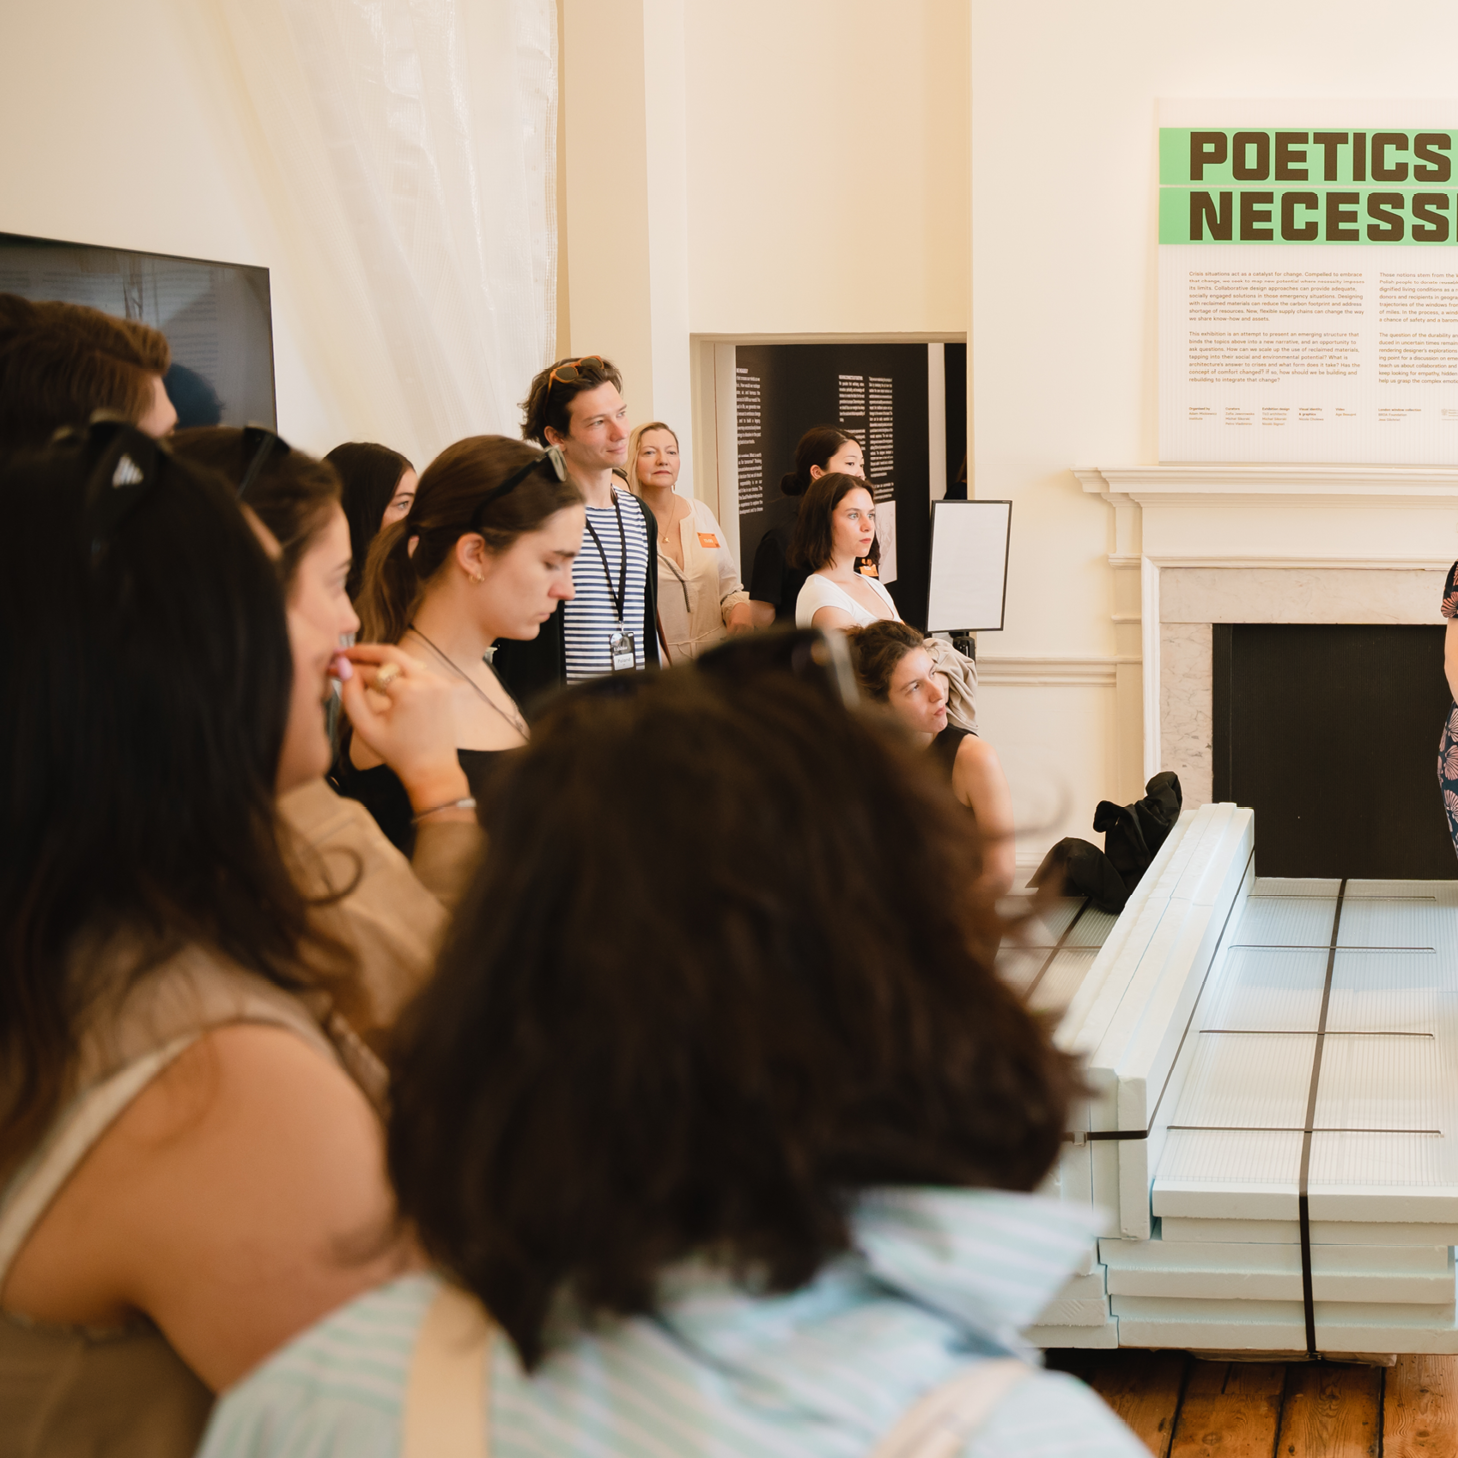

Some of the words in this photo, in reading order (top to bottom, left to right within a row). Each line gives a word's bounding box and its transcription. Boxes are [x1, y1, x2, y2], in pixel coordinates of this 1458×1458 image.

[1190, 132, 1451, 182] POETICS
[1283, 271, 1303, 279] change.
[1304, 271, 1332, 279] Compelled
[1250, 285, 1267, 293] design
[1268, 285, 1299, 293] approaches
[1402, 286, 1416, 294] living
[1279, 308, 1296, 316] supply
